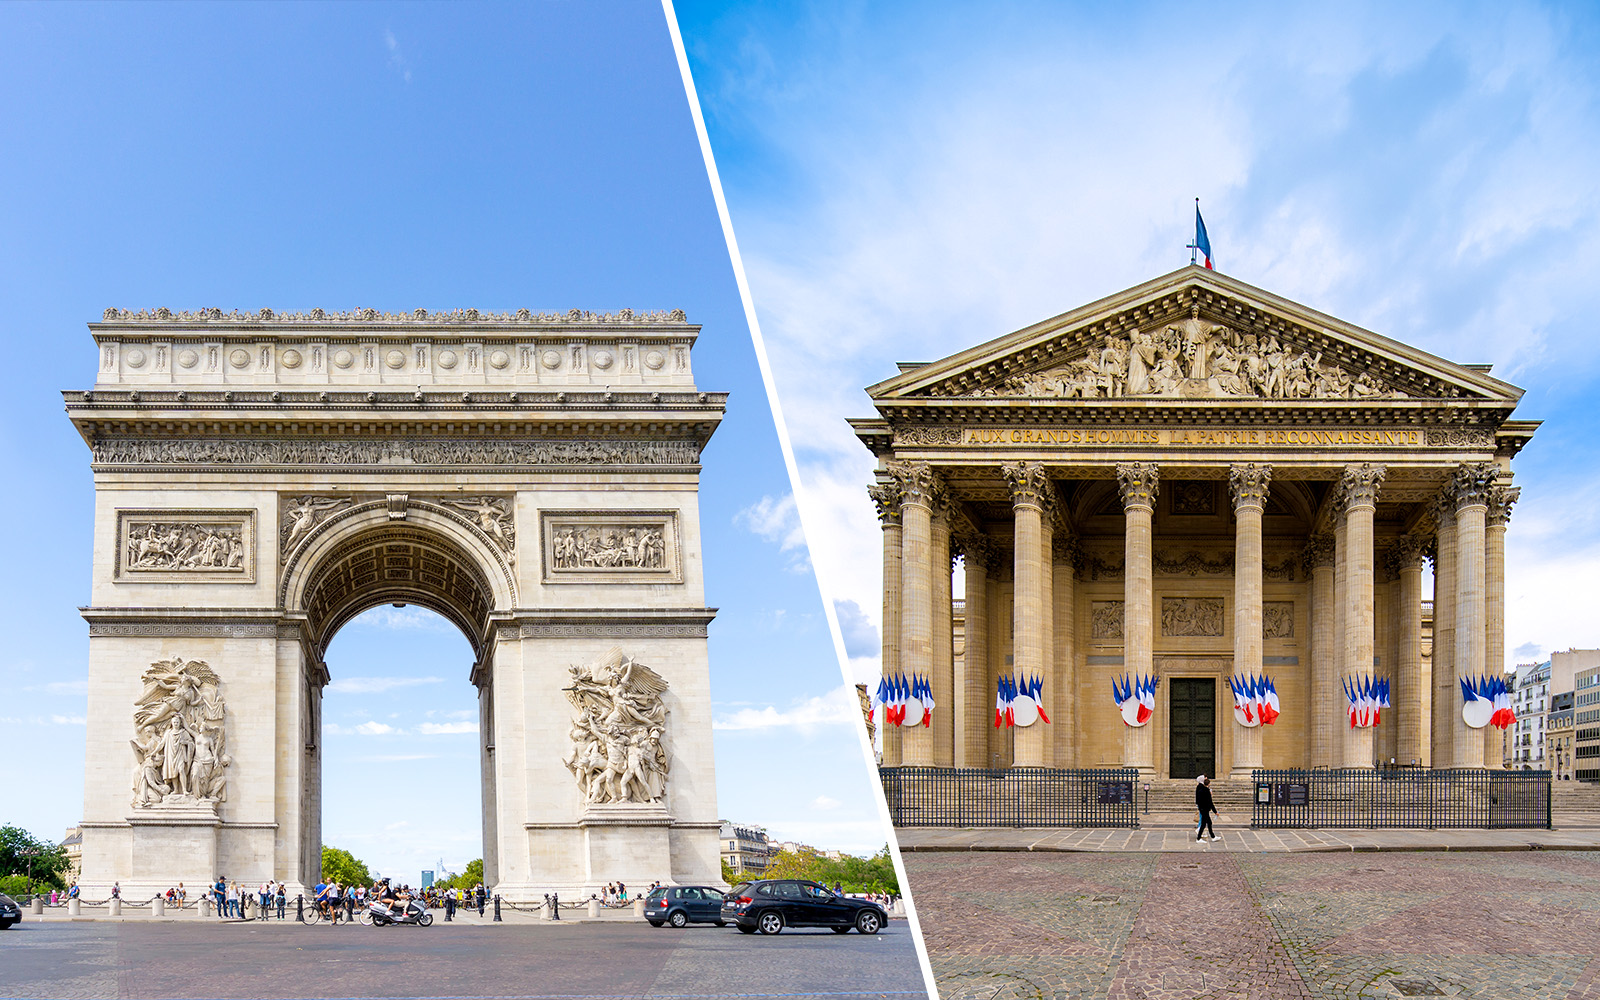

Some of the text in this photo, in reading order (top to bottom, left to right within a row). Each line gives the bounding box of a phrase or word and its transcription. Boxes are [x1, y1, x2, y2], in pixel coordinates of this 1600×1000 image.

[968, 429, 1419, 444] AUX GRANDS HOMMES LA PATRIE RECONNAISSANTE
